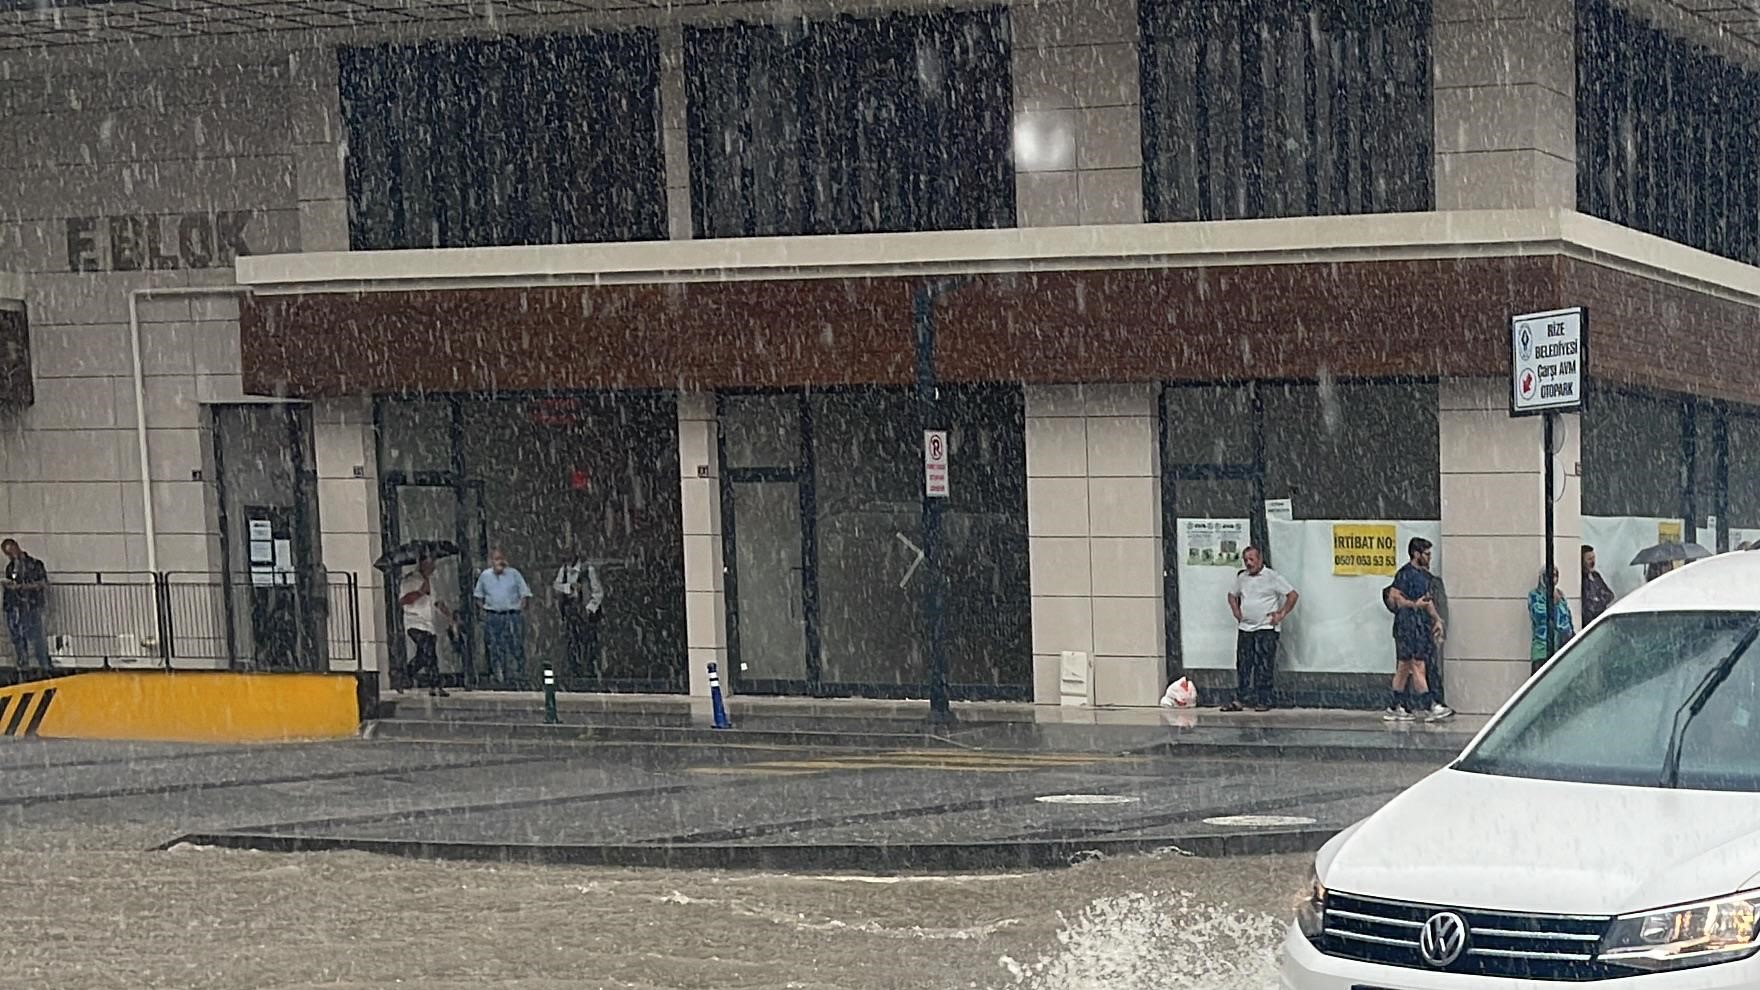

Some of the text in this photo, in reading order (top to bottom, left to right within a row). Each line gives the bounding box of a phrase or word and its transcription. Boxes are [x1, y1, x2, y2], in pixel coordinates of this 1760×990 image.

[1547, 322, 1565, 337] RİZE
[1535, 339, 1578, 359] BELEDİYESİ
[1559, 360, 1576, 376] AVM
[1540, 382, 1573, 399] OTOPARK
